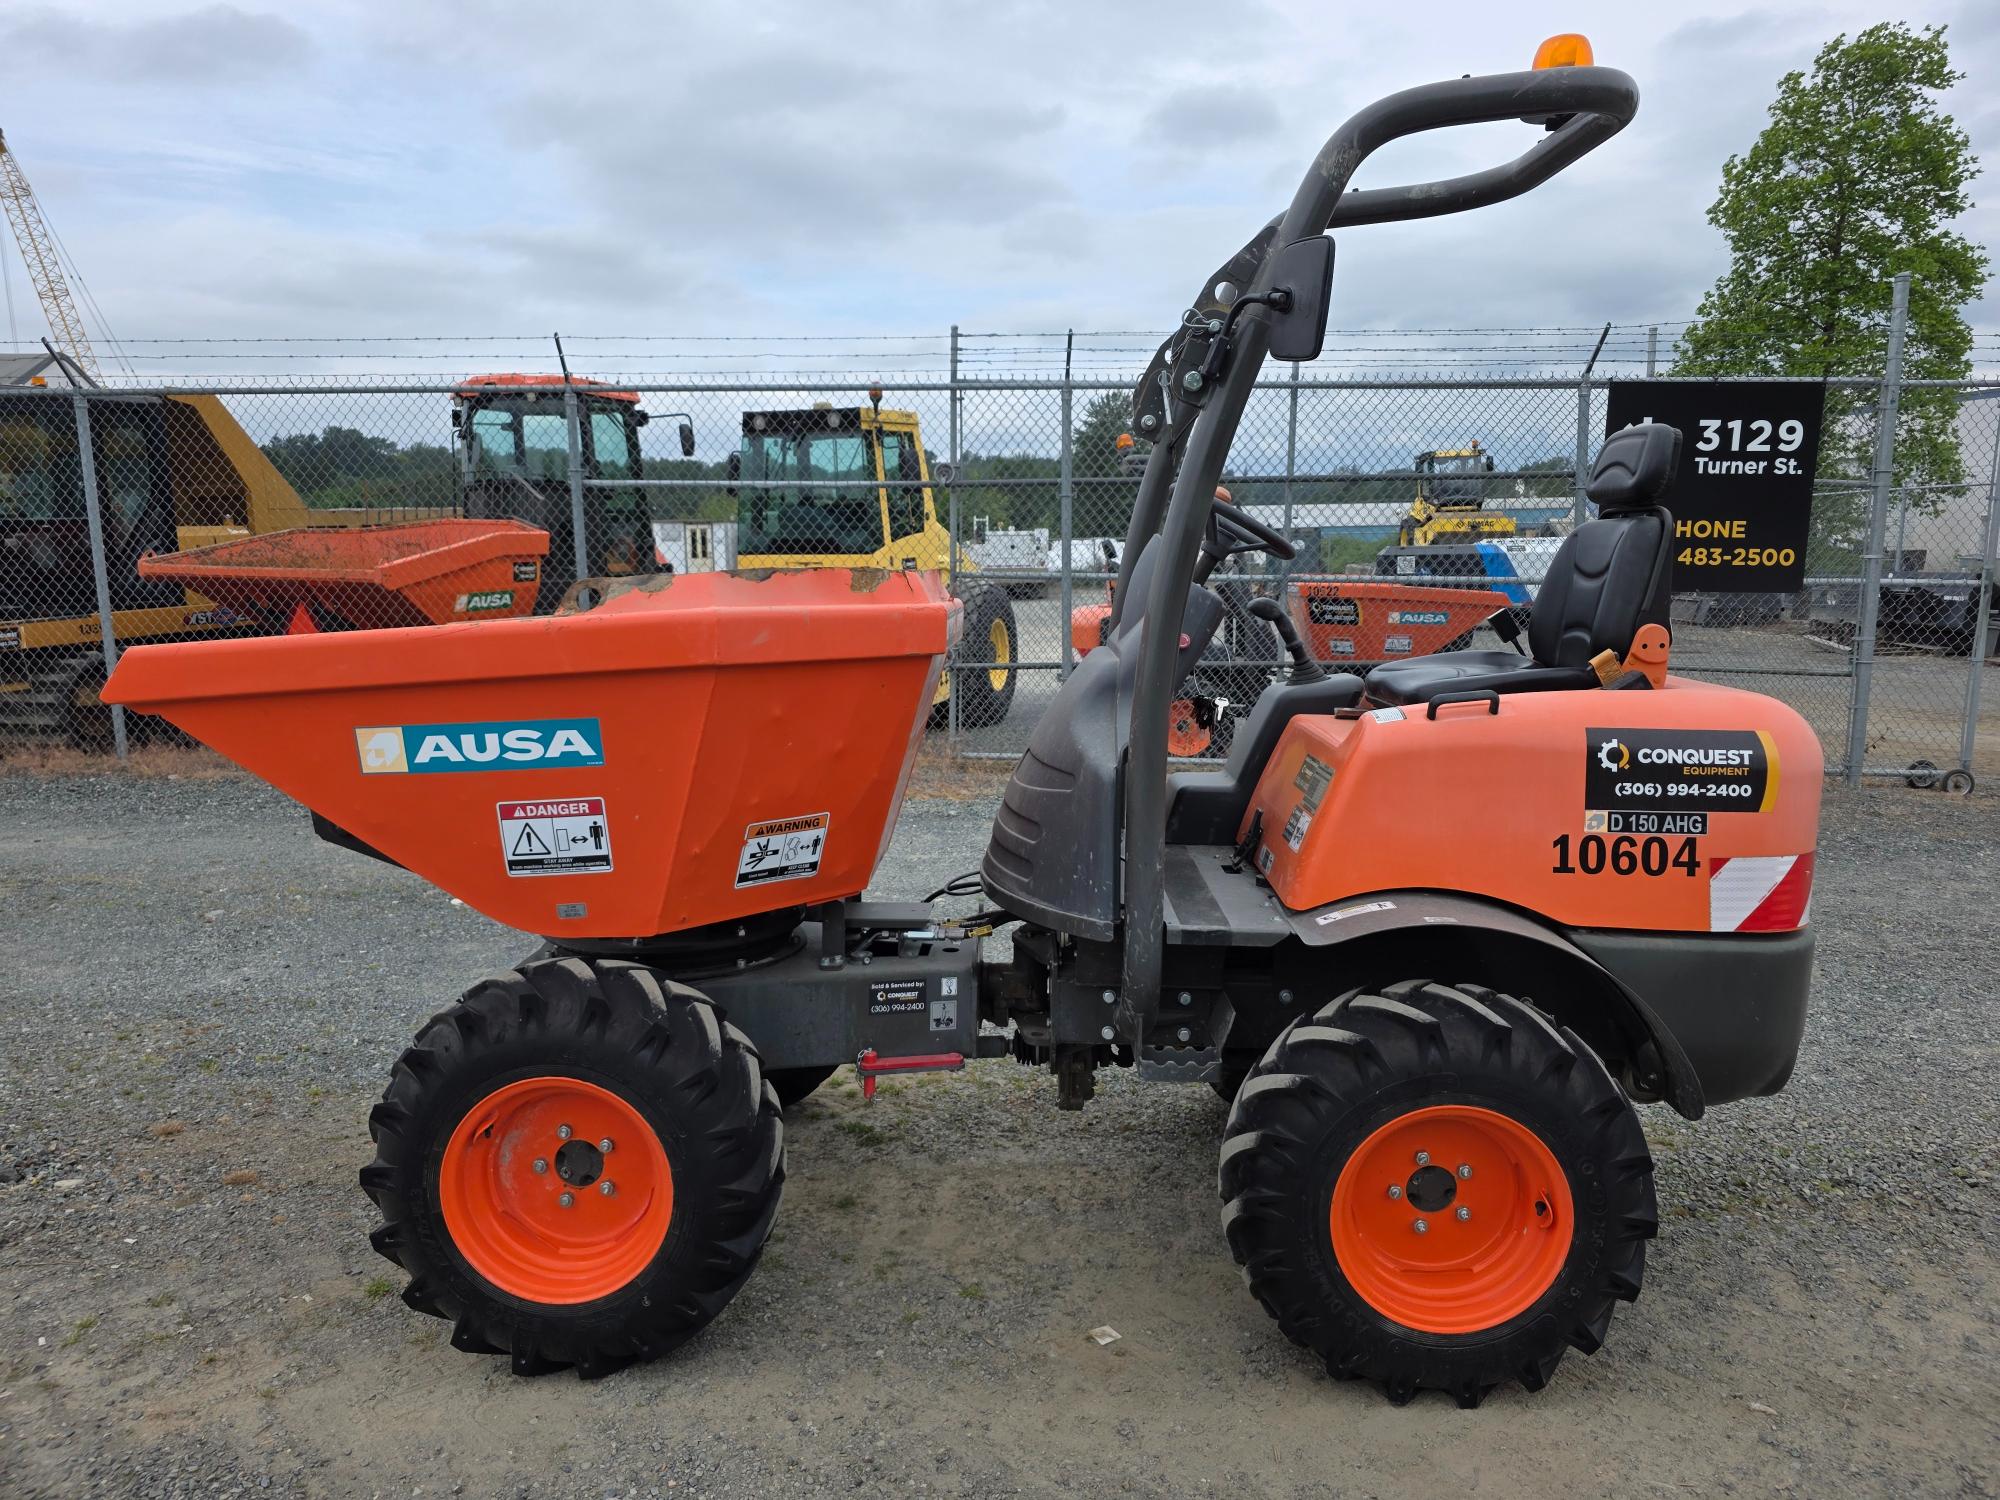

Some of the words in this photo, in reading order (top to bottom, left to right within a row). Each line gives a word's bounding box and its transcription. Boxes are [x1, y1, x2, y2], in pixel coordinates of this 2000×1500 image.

[1695, 419, 1804, 452] 3129
[1694, 457, 1768, 475] Turner
[1773, 457, 1803, 475] St.
[1673, 520, 1747, 539] HONE
[1677, 547, 1796, 567] 483-2500
[468, 593, 512, 608] AUSA
[1402, 613, 1447, 623] AUSA
[413, 729, 597, 764] AUSA
[1637, 748, 1753, 765] CONQUEST
[1683, 766, 1750, 776] EQUIPMENT
[1614, 782, 1662, 798] (306)
[1667, 783, 1752, 797] 994-2400
[526, 802, 590, 817] DANGER
[765, 817, 820, 834] WARNING
[1610, 813, 1624, 831] D
[1629, 814, 1659, 832] 150
[1662, 815, 1702, 833] AHG
[1552, 834, 1701, 877] 10604
[887, 991, 919, 999] CONQUEST
[871, 1004, 890, 1013] (306)
[891, 1002, 925, 1011] 994-2400
